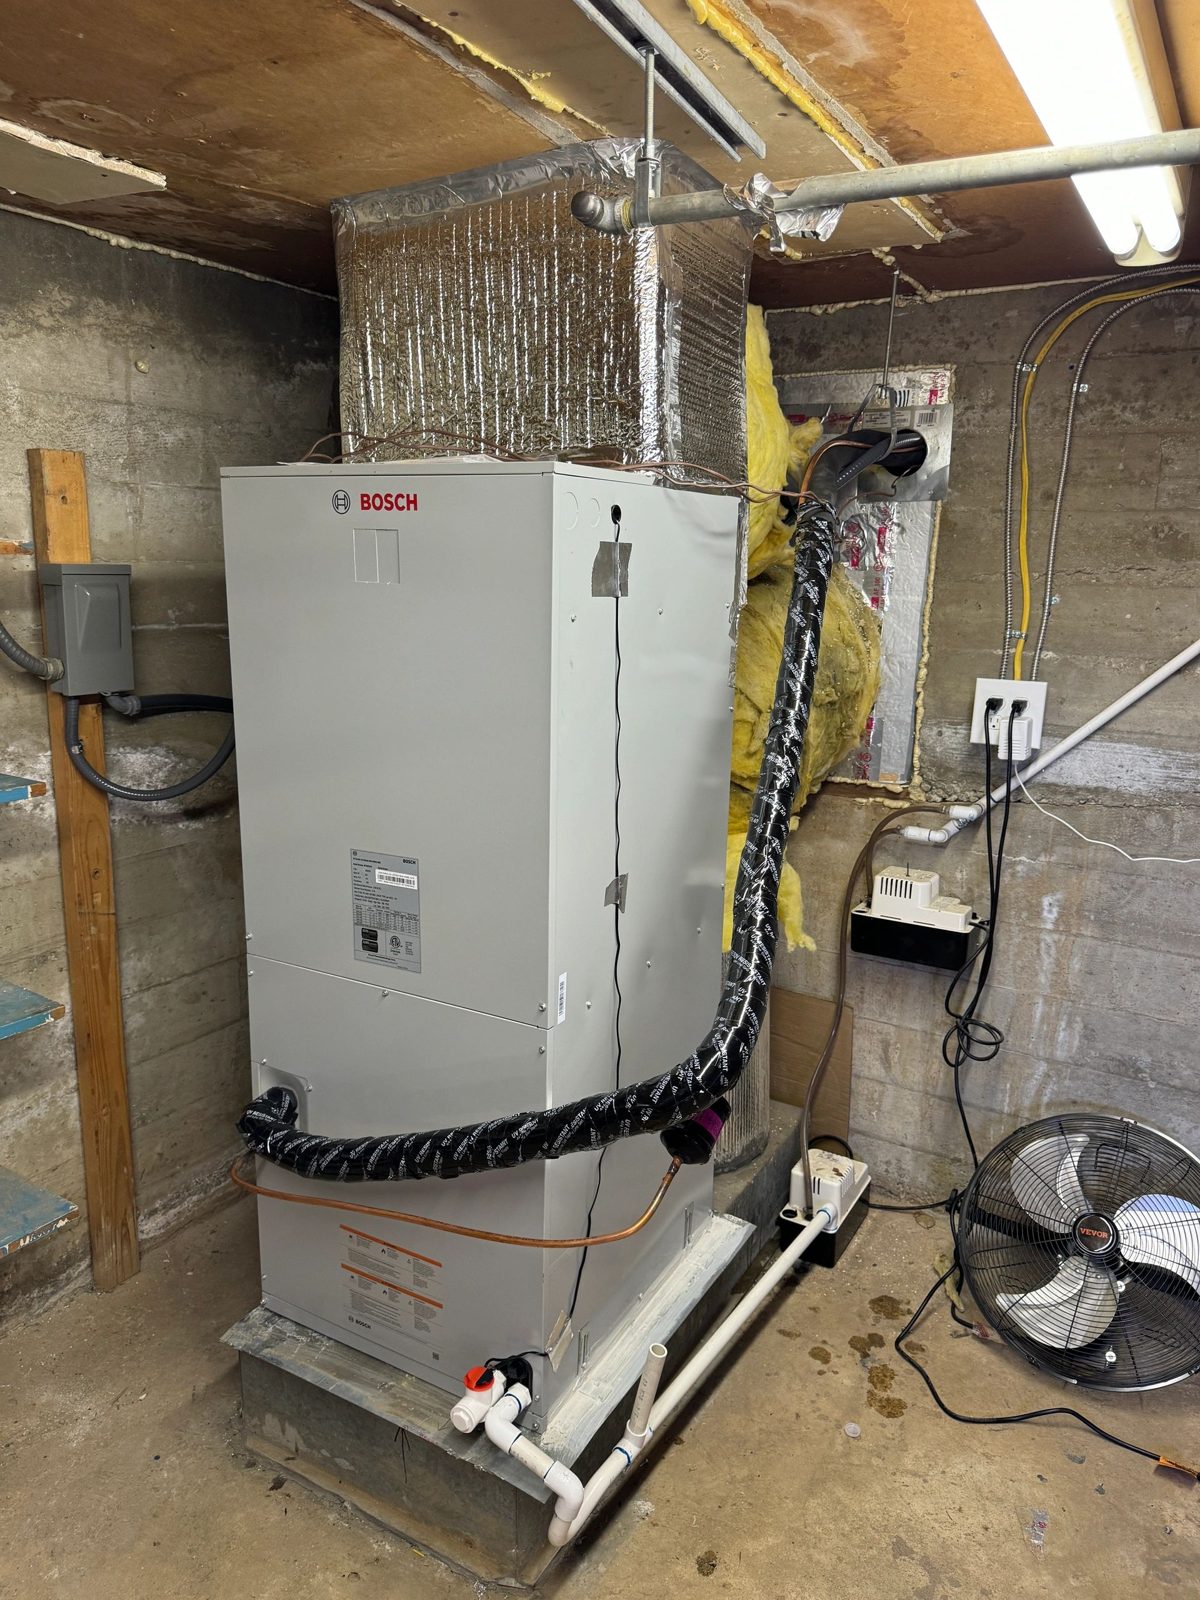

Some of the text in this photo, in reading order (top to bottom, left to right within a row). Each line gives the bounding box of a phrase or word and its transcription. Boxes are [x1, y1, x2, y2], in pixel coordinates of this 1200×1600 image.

[360, 493, 418, 511] BOSCH
[1080, 1227, 1108, 1239] VEVOR
[355, 1319, 372, 1330] BOSCH
